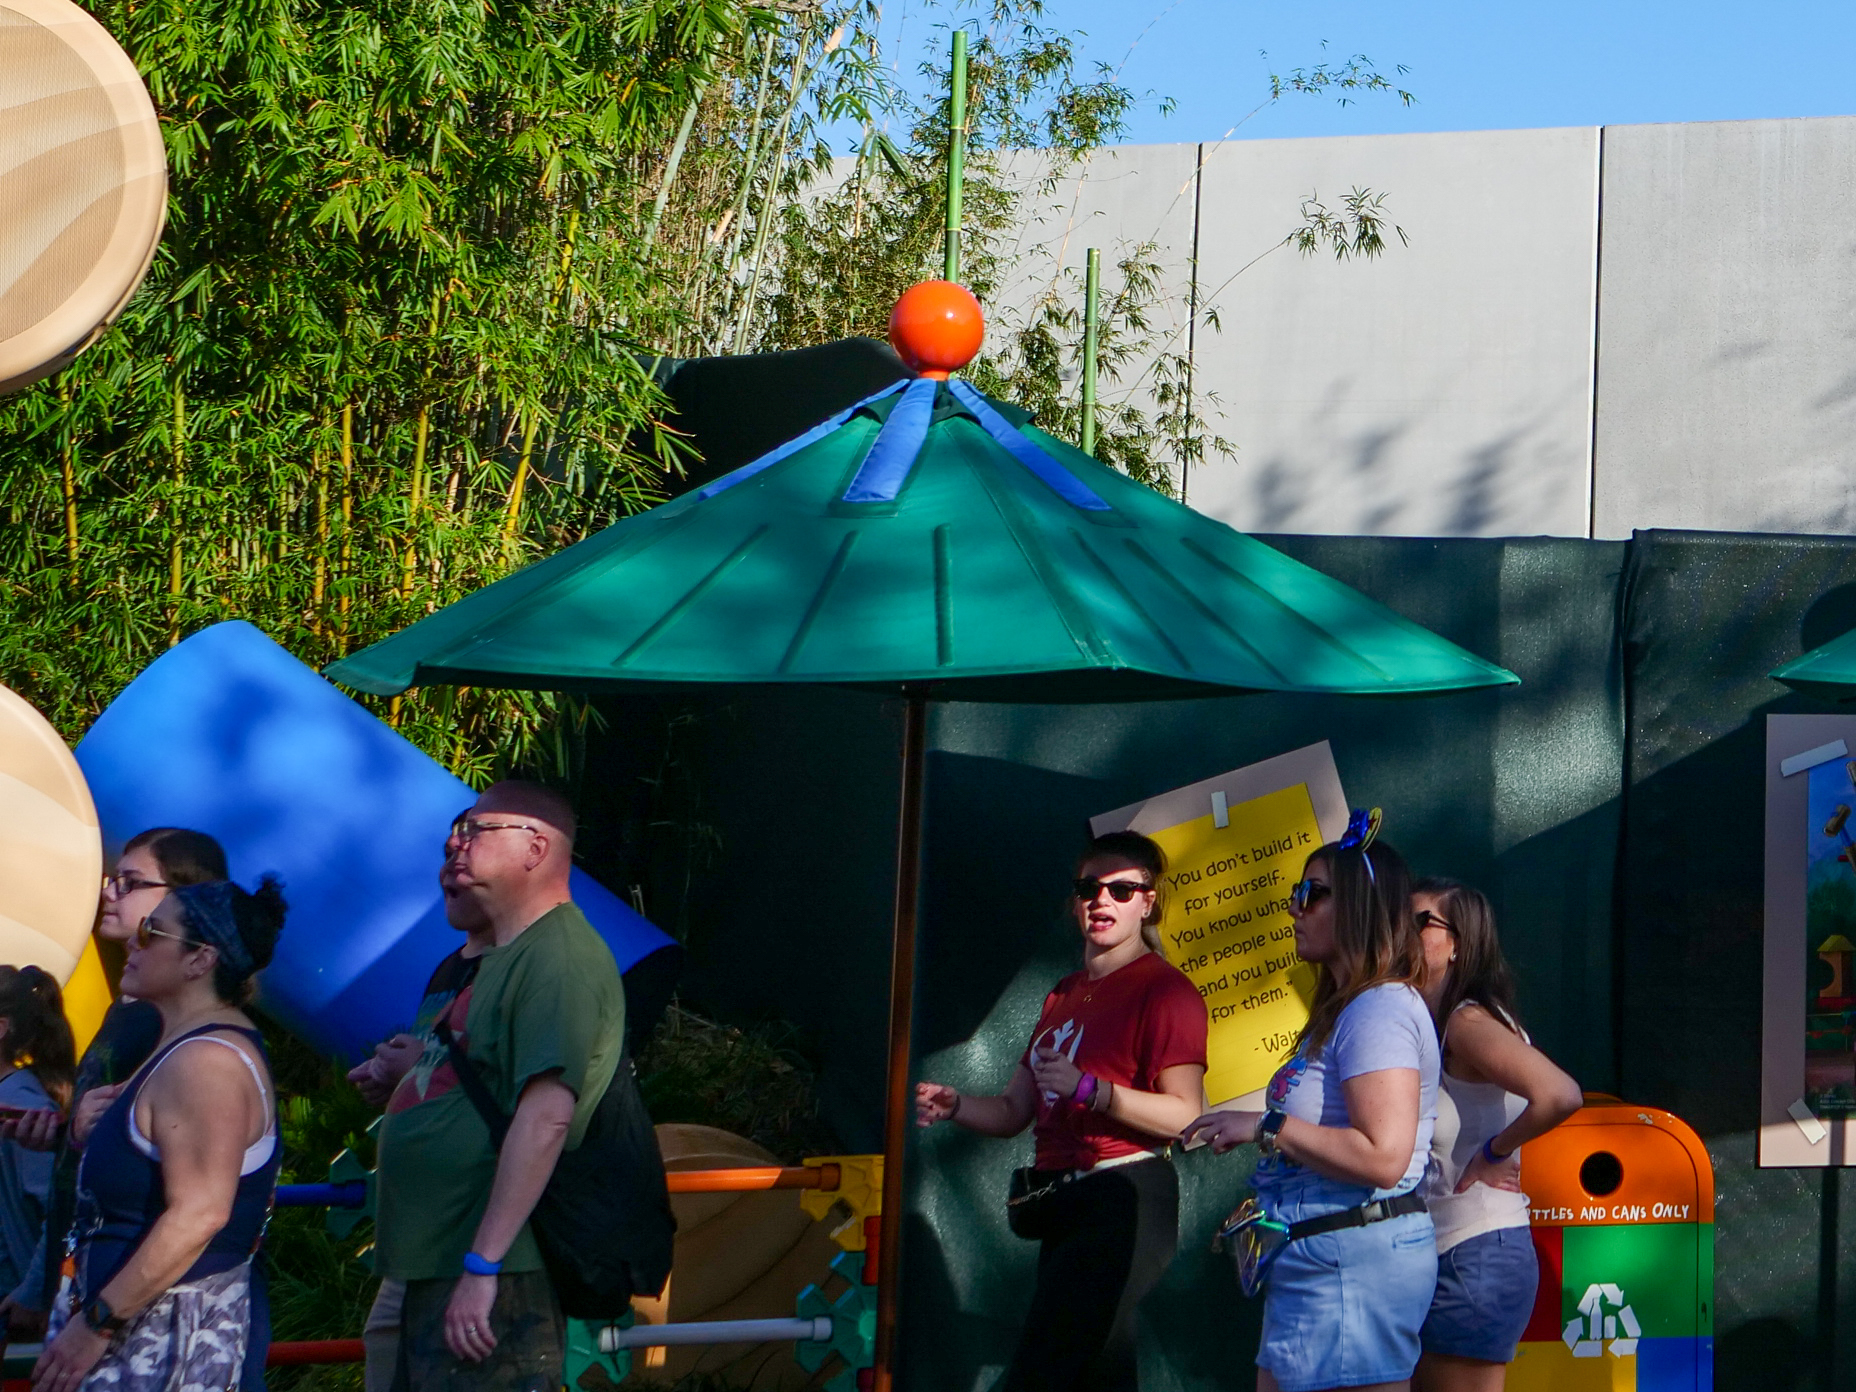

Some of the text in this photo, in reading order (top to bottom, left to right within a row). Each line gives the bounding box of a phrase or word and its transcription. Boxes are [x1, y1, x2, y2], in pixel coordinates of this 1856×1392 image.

[1206, 853, 1248, 877] don't
[1252, 835, 1293, 862] build
[1297, 830, 1311, 846] it
[1185, 868, 1285, 915] for yourself.
[1169, 926, 1205, 948] You
[1208, 910, 1252, 934] know
[1179, 923, 1295, 973] the people wa
[1197, 974, 1229, 997] and
[1231, 965, 1261, 986] you
[1211, 1003, 1236, 1024] for
[1527, 1207, 1573, 1220] TTLES
[1579, 1205, 1606, 1221] AND
[1651, 1202, 1689, 1219] ONLY
